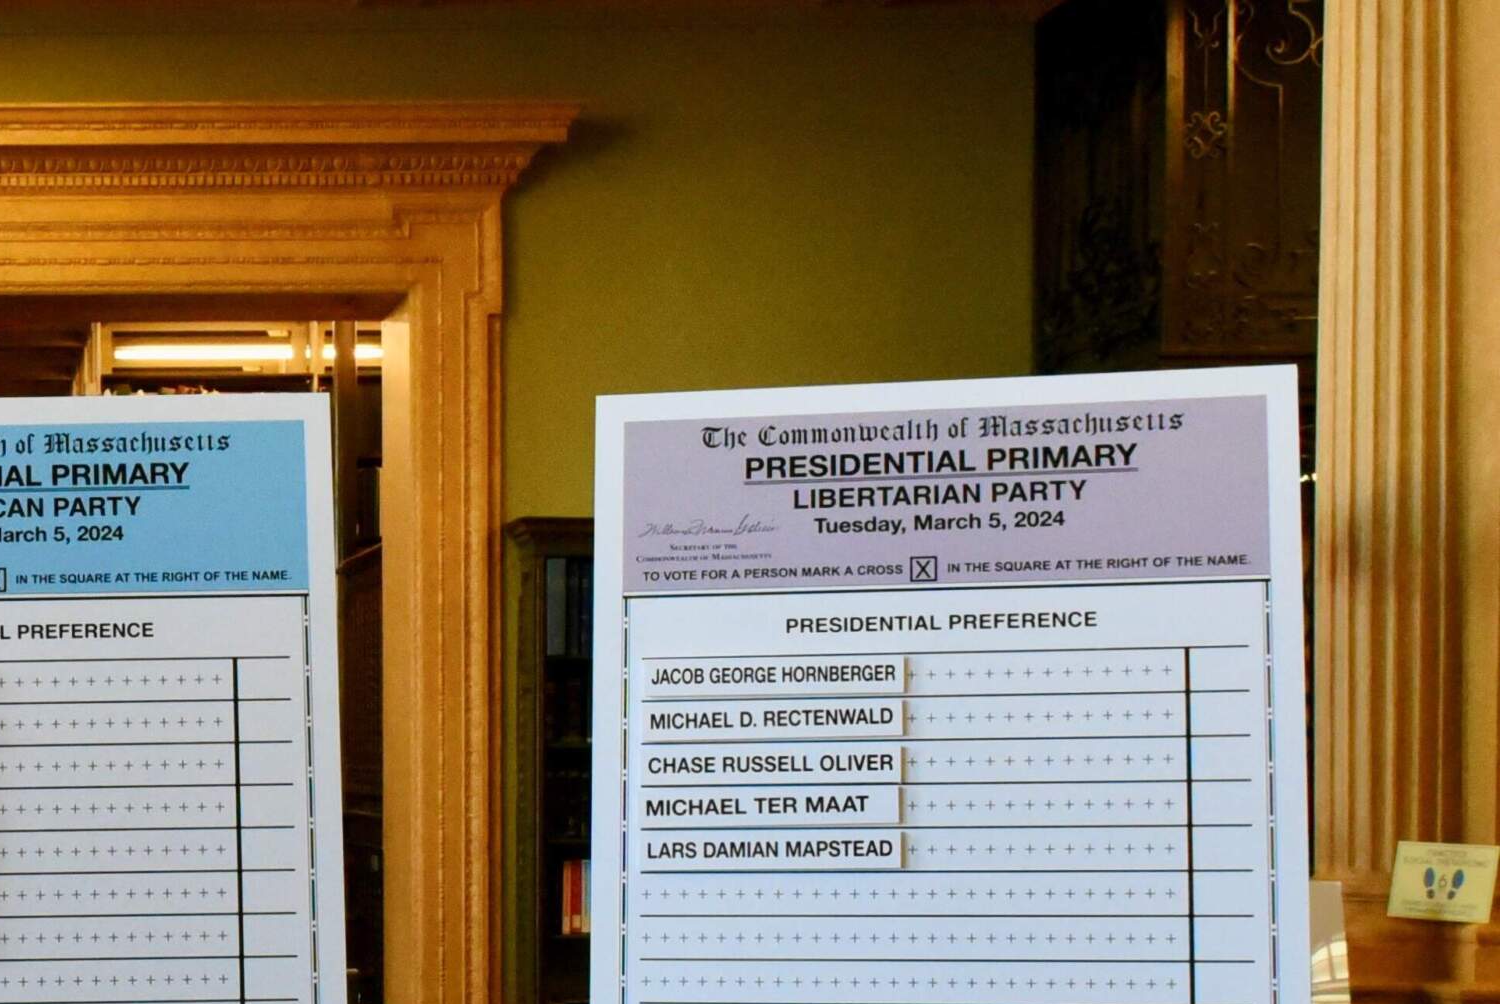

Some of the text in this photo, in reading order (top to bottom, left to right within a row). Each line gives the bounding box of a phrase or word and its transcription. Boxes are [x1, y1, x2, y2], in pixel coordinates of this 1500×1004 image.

[702, 413, 1183, 449] The Commonwealth of Massachusetts
[15, 433, 35, 455] of
[44, 431, 230, 454] Massachusetts
[746, 443, 1137, 480] PRESIDENTIAL PRIMARY
[51, 462, 189, 486] PRIMARY
[53, 495, 141, 517] PARTY
[794, 479, 1087, 510] LIBERTARIAN PARTY
[813, 510, 1065, 536] Tuesday, March 5, 2024
[53, 526, 71, 545] 5,
[77, 525, 124, 542] 2024
[15, 574, 28, 585] IN
[32, 574, 55, 584] THE
[59, 573, 111, 584] SQUARE
[115, 572, 130, 583] AT
[134, 572, 158, 583] THE
[162, 571, 200, 582] RIGHT
[203, 571, 220, 582] OF
[224, 570, 248, 581] THE
[643, 571, 660, 581] TO
[663, 570, 697, 581] VOTE
[701, 569, 727, 580] FOR
[731, 569, 741, 579] A
[744, 567, 798, 579] PERSON
[801, 566, 840, 577] MARK
[843, 565, 854, 576] A
[857, 564, 903, 576] CROSS
[915, 560, 931, 579] X
[947, 563, 961, 573] IN
[964, 561, 990, 573] THE
[994, 560, 1051, 572] SQUARE
[1055, 559, 1072, 570] AT
[1076, 559, 1102, 569] THE
[1106, 557, 1148, 569] RIGHT
[1152, 556, 1171, 568] OF
[1176, 556, 1202, 567] THE
[17, 622, 154, 640] PREFERENCE
[786, 611, 1097, 634] PRESIDENTIAL PREFERENCE
[651, 664, 896, 685] JACOB GEORGE HORNBERGER
[650, 707, 893, 730] MICHAEL D. RECTENWALD
[648, 754, 893, 774] CHASE RUSSELL OLIVER
[646, 795, 869, 817] MICHAEL TER MAAT
[647, 839, 893, 859] LARS DAMIAN MAPSTEAD
